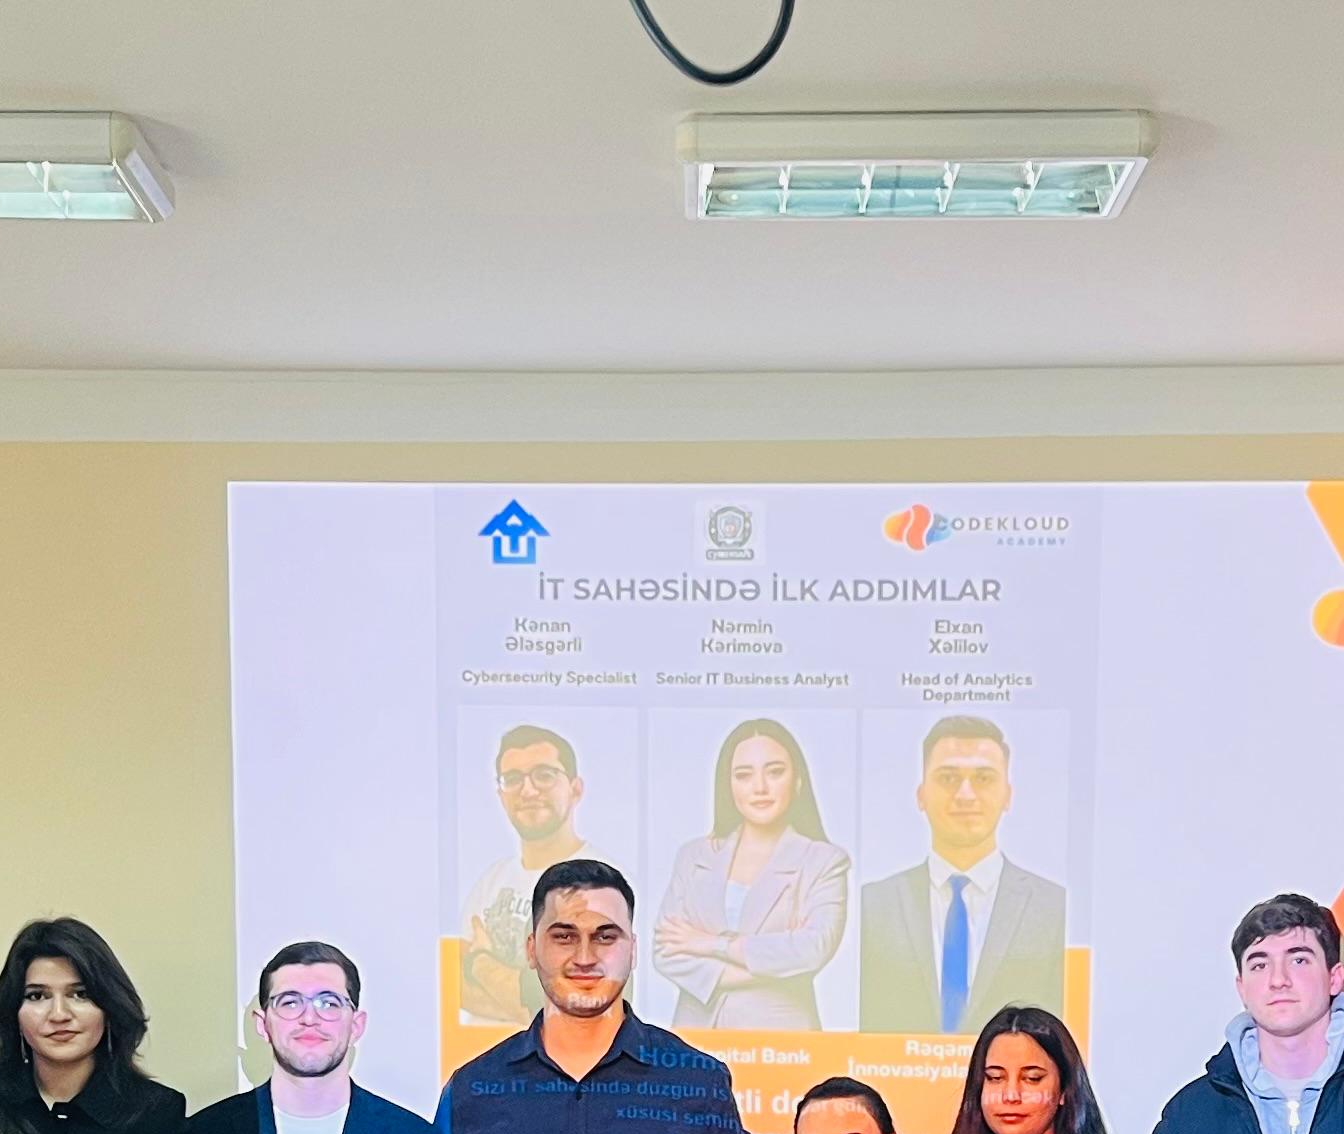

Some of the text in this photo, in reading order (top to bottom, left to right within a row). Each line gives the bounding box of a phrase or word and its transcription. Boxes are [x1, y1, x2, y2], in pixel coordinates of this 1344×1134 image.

[997, 537, 1066, 546] ACADEMY
[539, 571, 1002, 603] İT SAHƏSİNDƏ İLK ADDIMLAR
[514, 617, 572, 633] Kənan
[711, 618, 774, 634] Nərmin
[934, 619, 984, 635] Elxan
[701, 638, 783, 654] Kərimova
[461, 670, 638, 687] Cybersecurity Specialist
[655, 672, 850, 689] Senior IT Business Analyst
[901, 673, 1033, 689] Head of Analytics
[922, 689, 1011, 704] Department
